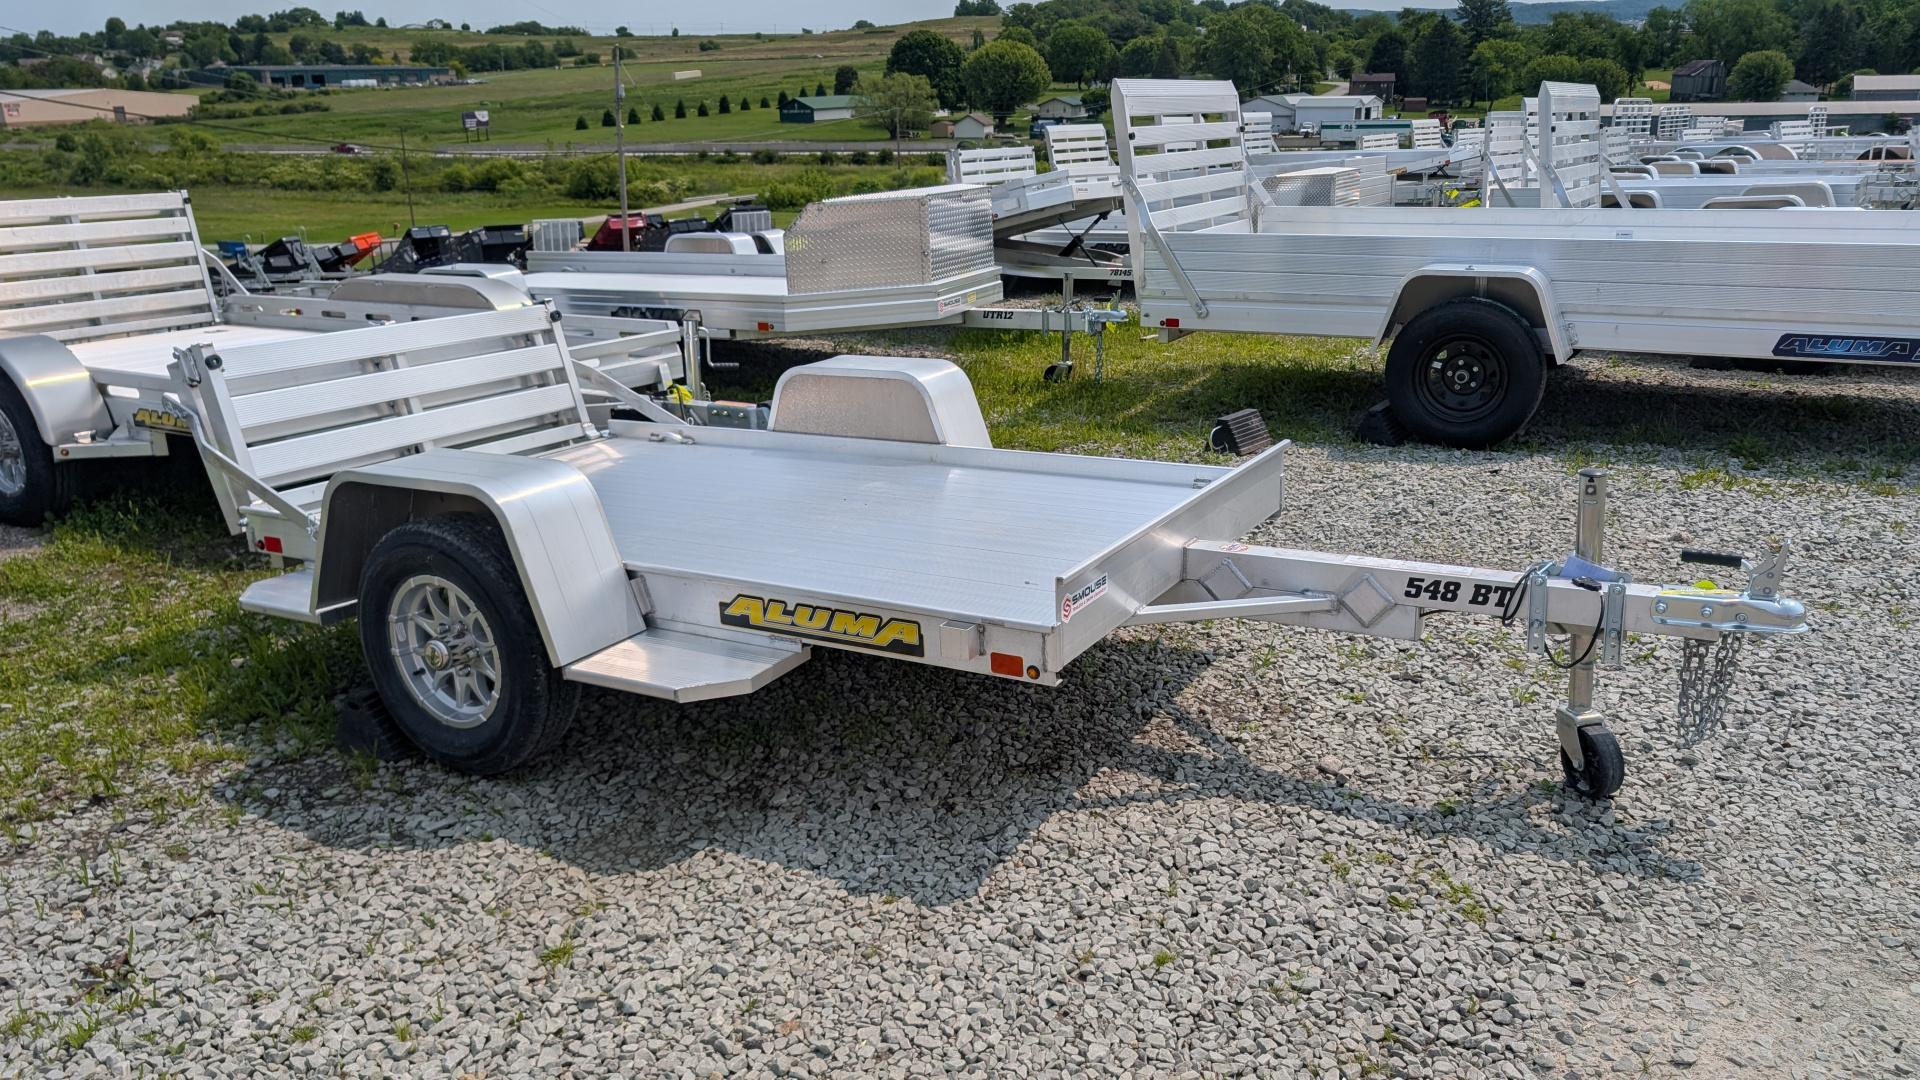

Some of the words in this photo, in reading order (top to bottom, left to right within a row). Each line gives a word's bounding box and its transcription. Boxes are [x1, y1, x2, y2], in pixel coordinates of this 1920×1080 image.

[982, 310, 1015, 320] UTR12
[1779, 337, 1910, 358] ALUMA
[1072, 575, 1107, 606] SMOUSE
[1404, 577, 1462, 603] 548
[1468, 583, 1517, 608] BT
[723, 596, 920, 647] ALUMA
